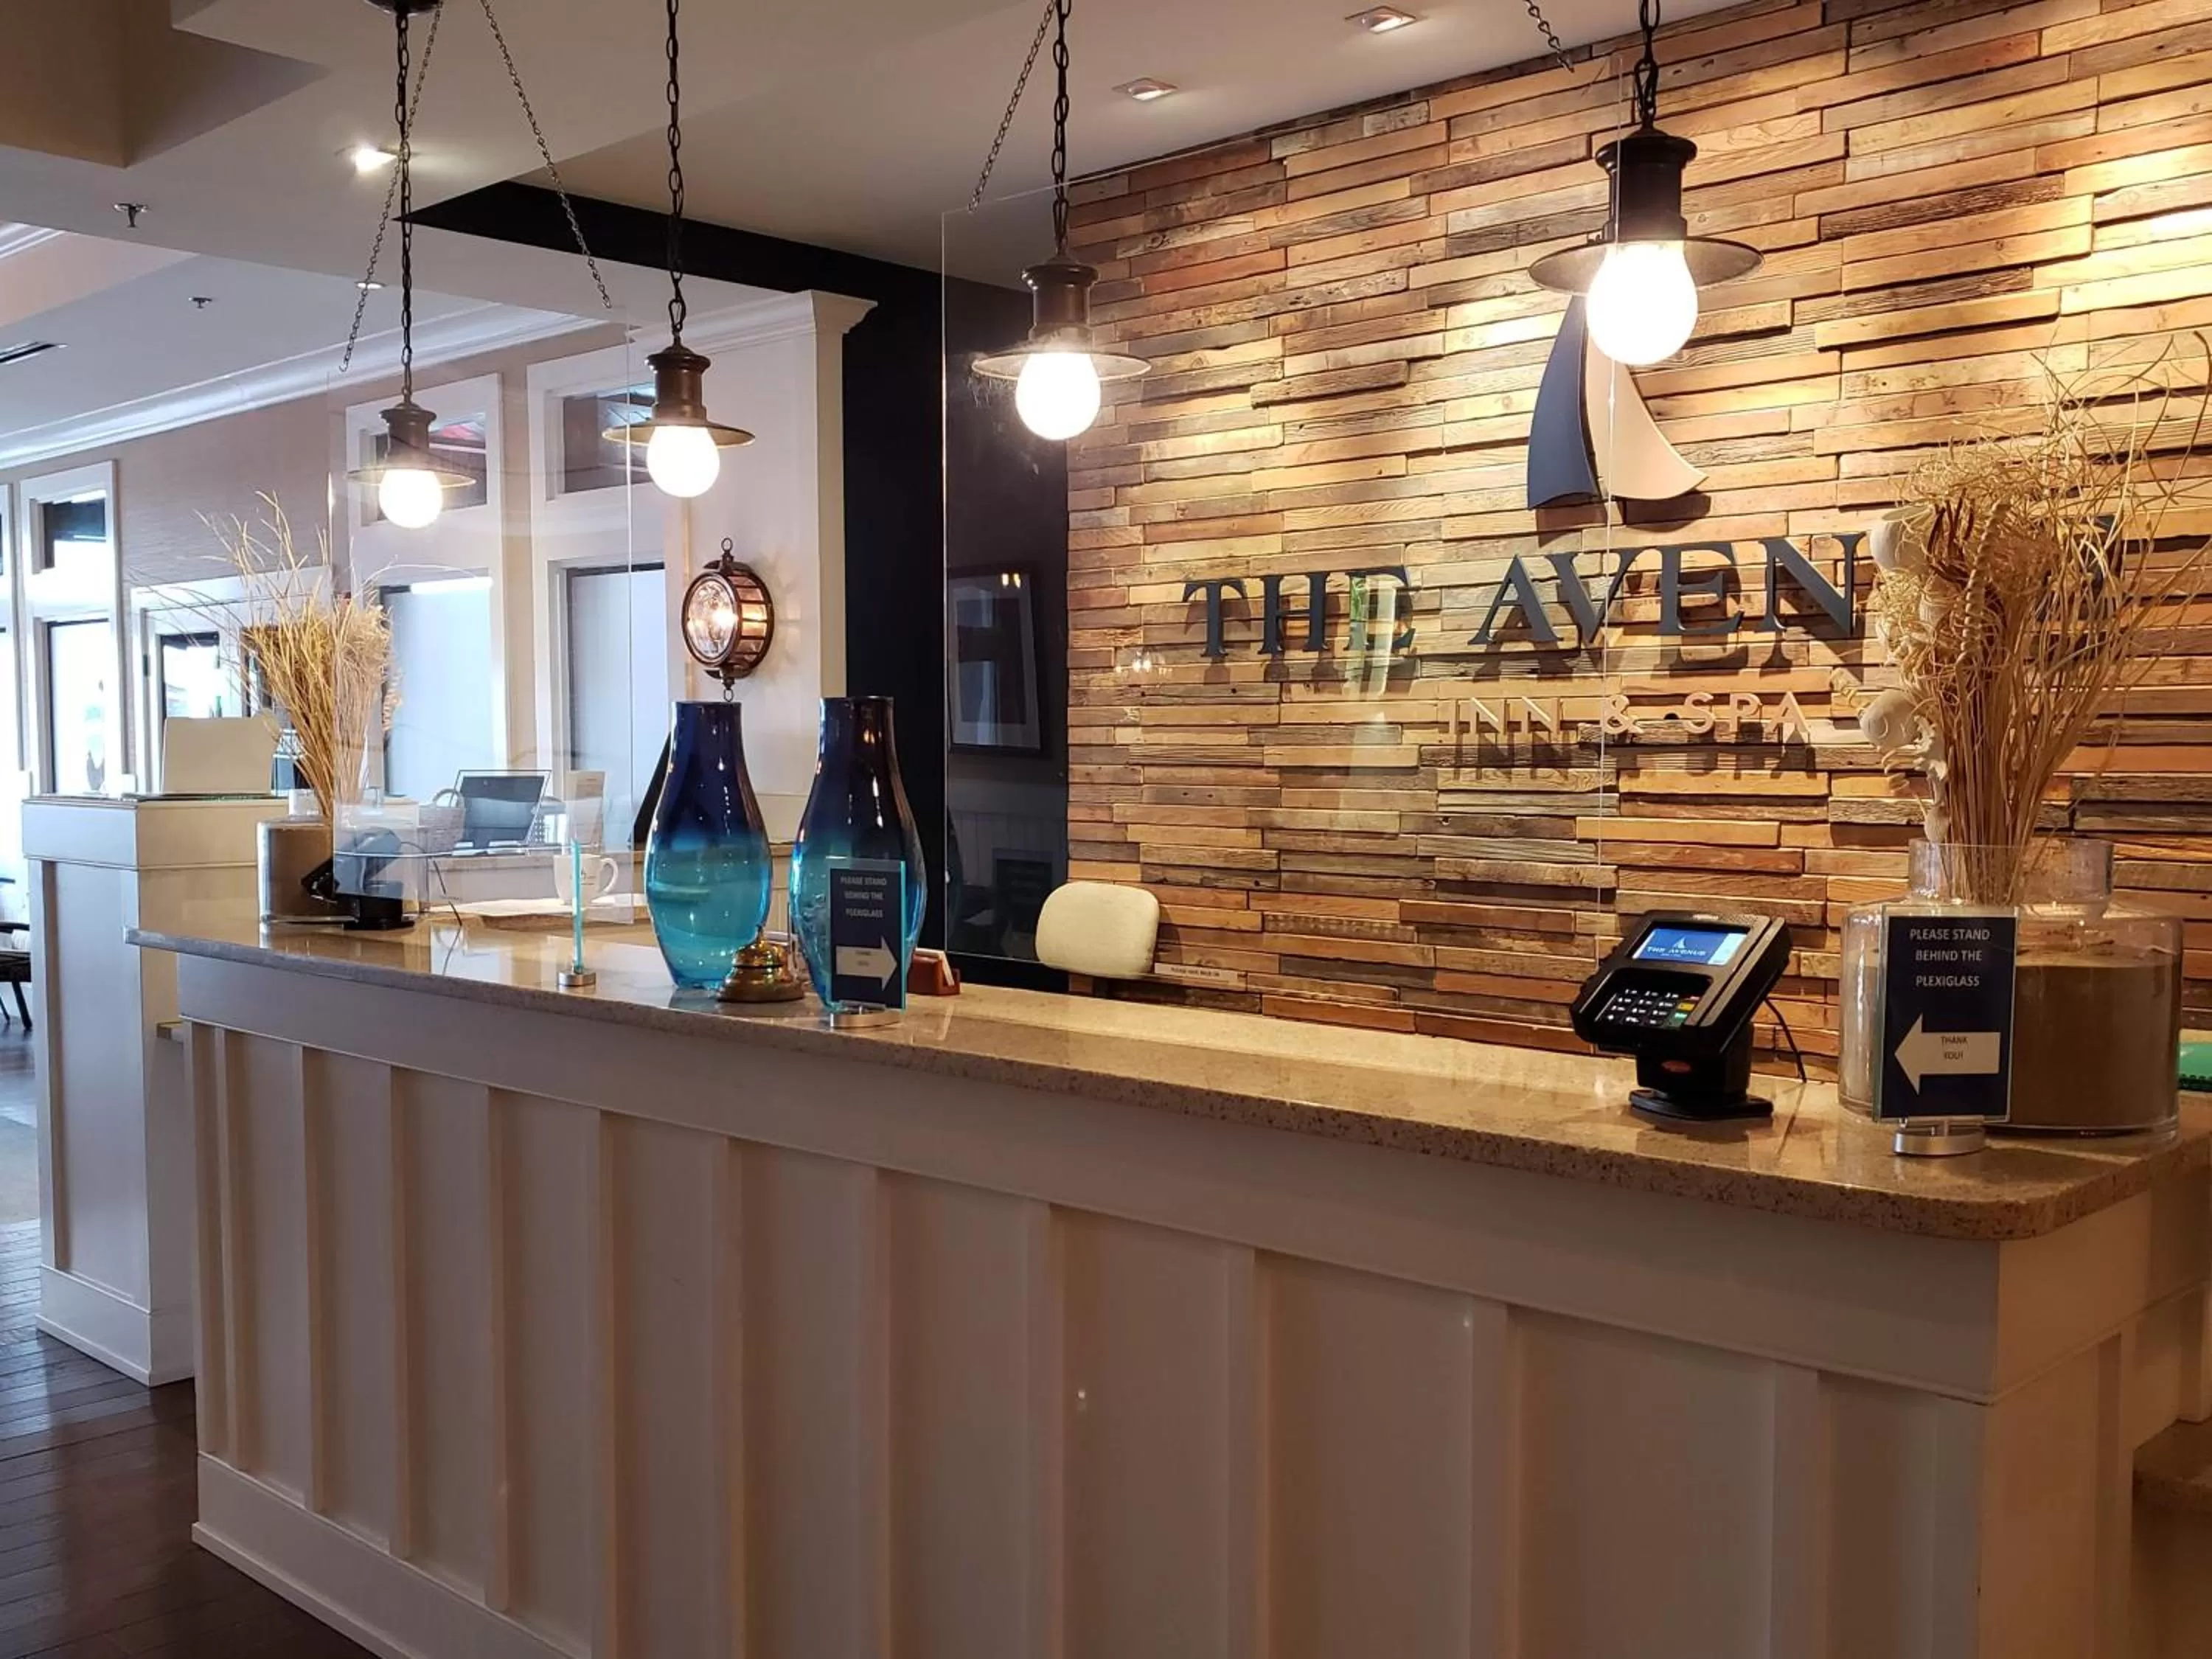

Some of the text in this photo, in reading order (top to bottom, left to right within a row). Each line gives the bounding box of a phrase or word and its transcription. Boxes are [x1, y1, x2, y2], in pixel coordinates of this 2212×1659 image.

[1182, 565, 1416, 658] THE
[1449, 691, 1811, 736] INN & SPA
[1910, 928, 1990, 941] PLEASE STAND
[1916, 949, 1982, 961] BEHIND THE
[1916, 975, 1980, 987] PLEXIGLASS
[1940, 1035, 1969, 1045] THANK
